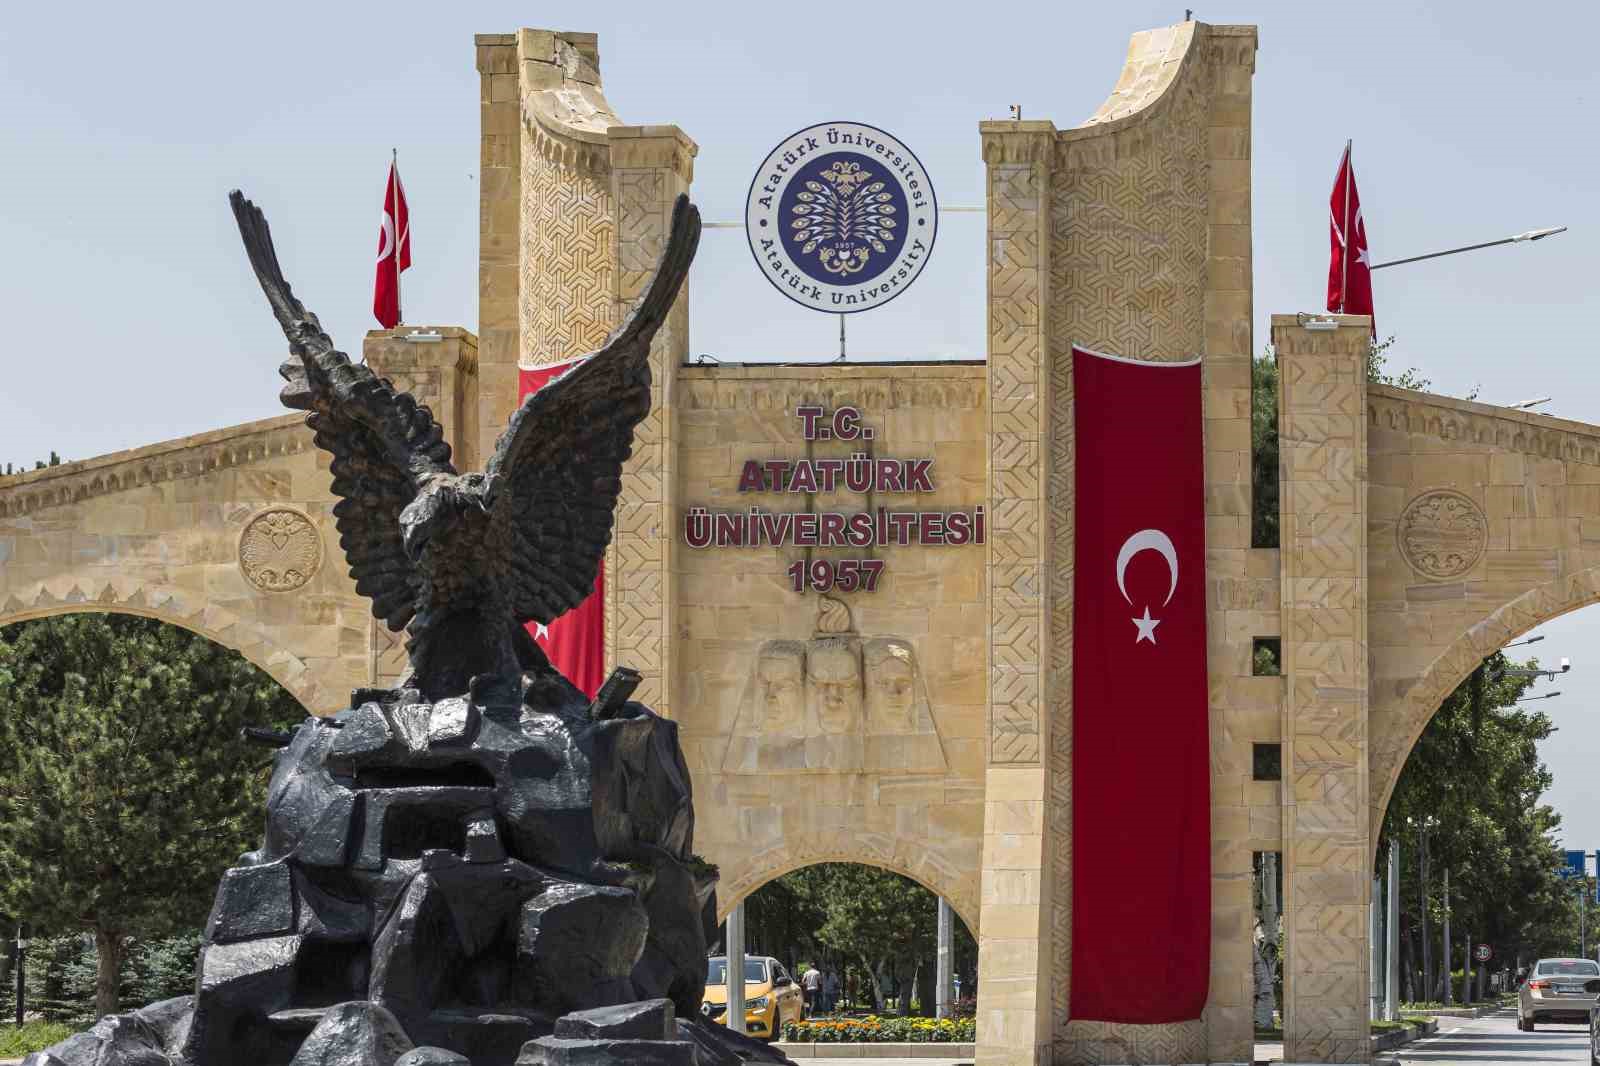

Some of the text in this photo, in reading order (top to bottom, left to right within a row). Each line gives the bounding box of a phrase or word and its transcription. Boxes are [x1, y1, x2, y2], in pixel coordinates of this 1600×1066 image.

[759, 128, 927, 210] Atatürk Üniversitesi
[760, 238, 926, 305] Atatürk University
[796, 406, 874, 441] T.C.
[737, 452, 935, 493] ATATÜRK
[685, 505, 985, 548] ÜNİVERSİTESİ
[788, 559, 885, 593] 1957
